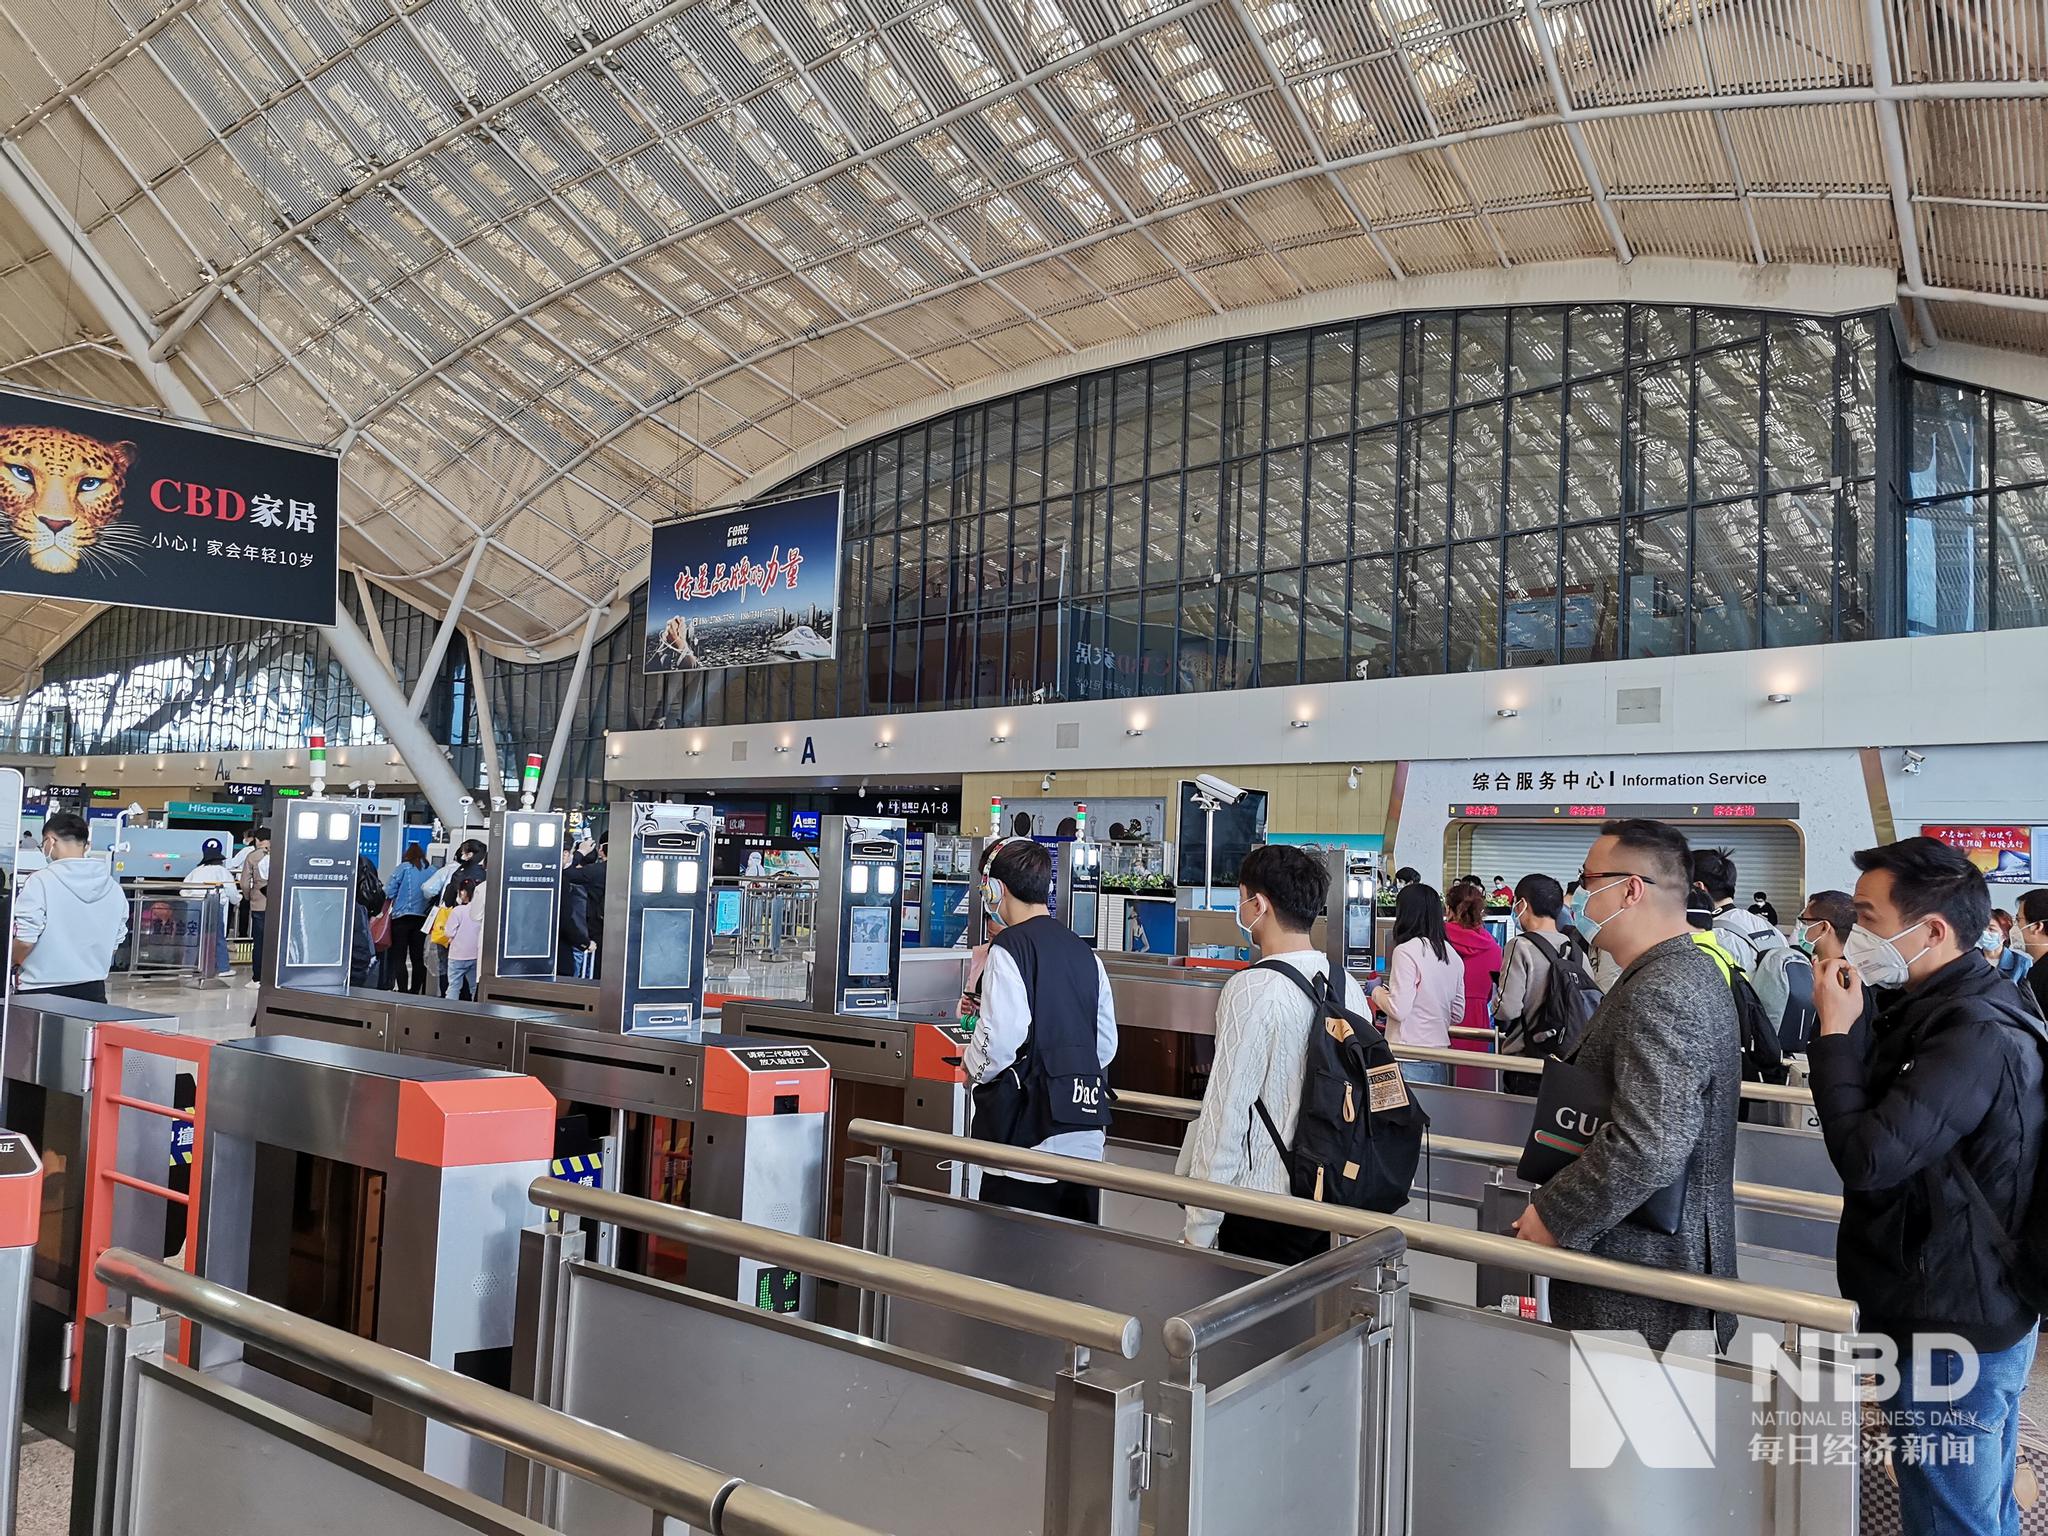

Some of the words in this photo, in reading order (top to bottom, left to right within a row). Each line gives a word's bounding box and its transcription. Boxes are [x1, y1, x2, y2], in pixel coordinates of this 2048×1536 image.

[674, 545, 804, 603] 传递品牌的力量
[801, 736, 817, 765] A
[1472, 770, 1605, 791] 综合服务中心
[1622, 773, 1704, 787] Information
[1709, 772, 1767, 785] Service
[188, 804, 234, 814] Hisense
[921, 801, 949, 814] A1-8
[1465, 805, 1499, 816] 综合查询
[1554, 806, 1560, 814] 6
[1568, 805, 1607, 816] 综合查询
[1692, 806, 1698, 814] 7
[1713, 805, 1755, 816] 综合查询
[747, 1049, 810, 1059] 请将二代身份证
[759, 1057, 805, 1066] 放入验证口
[1555, 1107, 1614, 1136] GU
